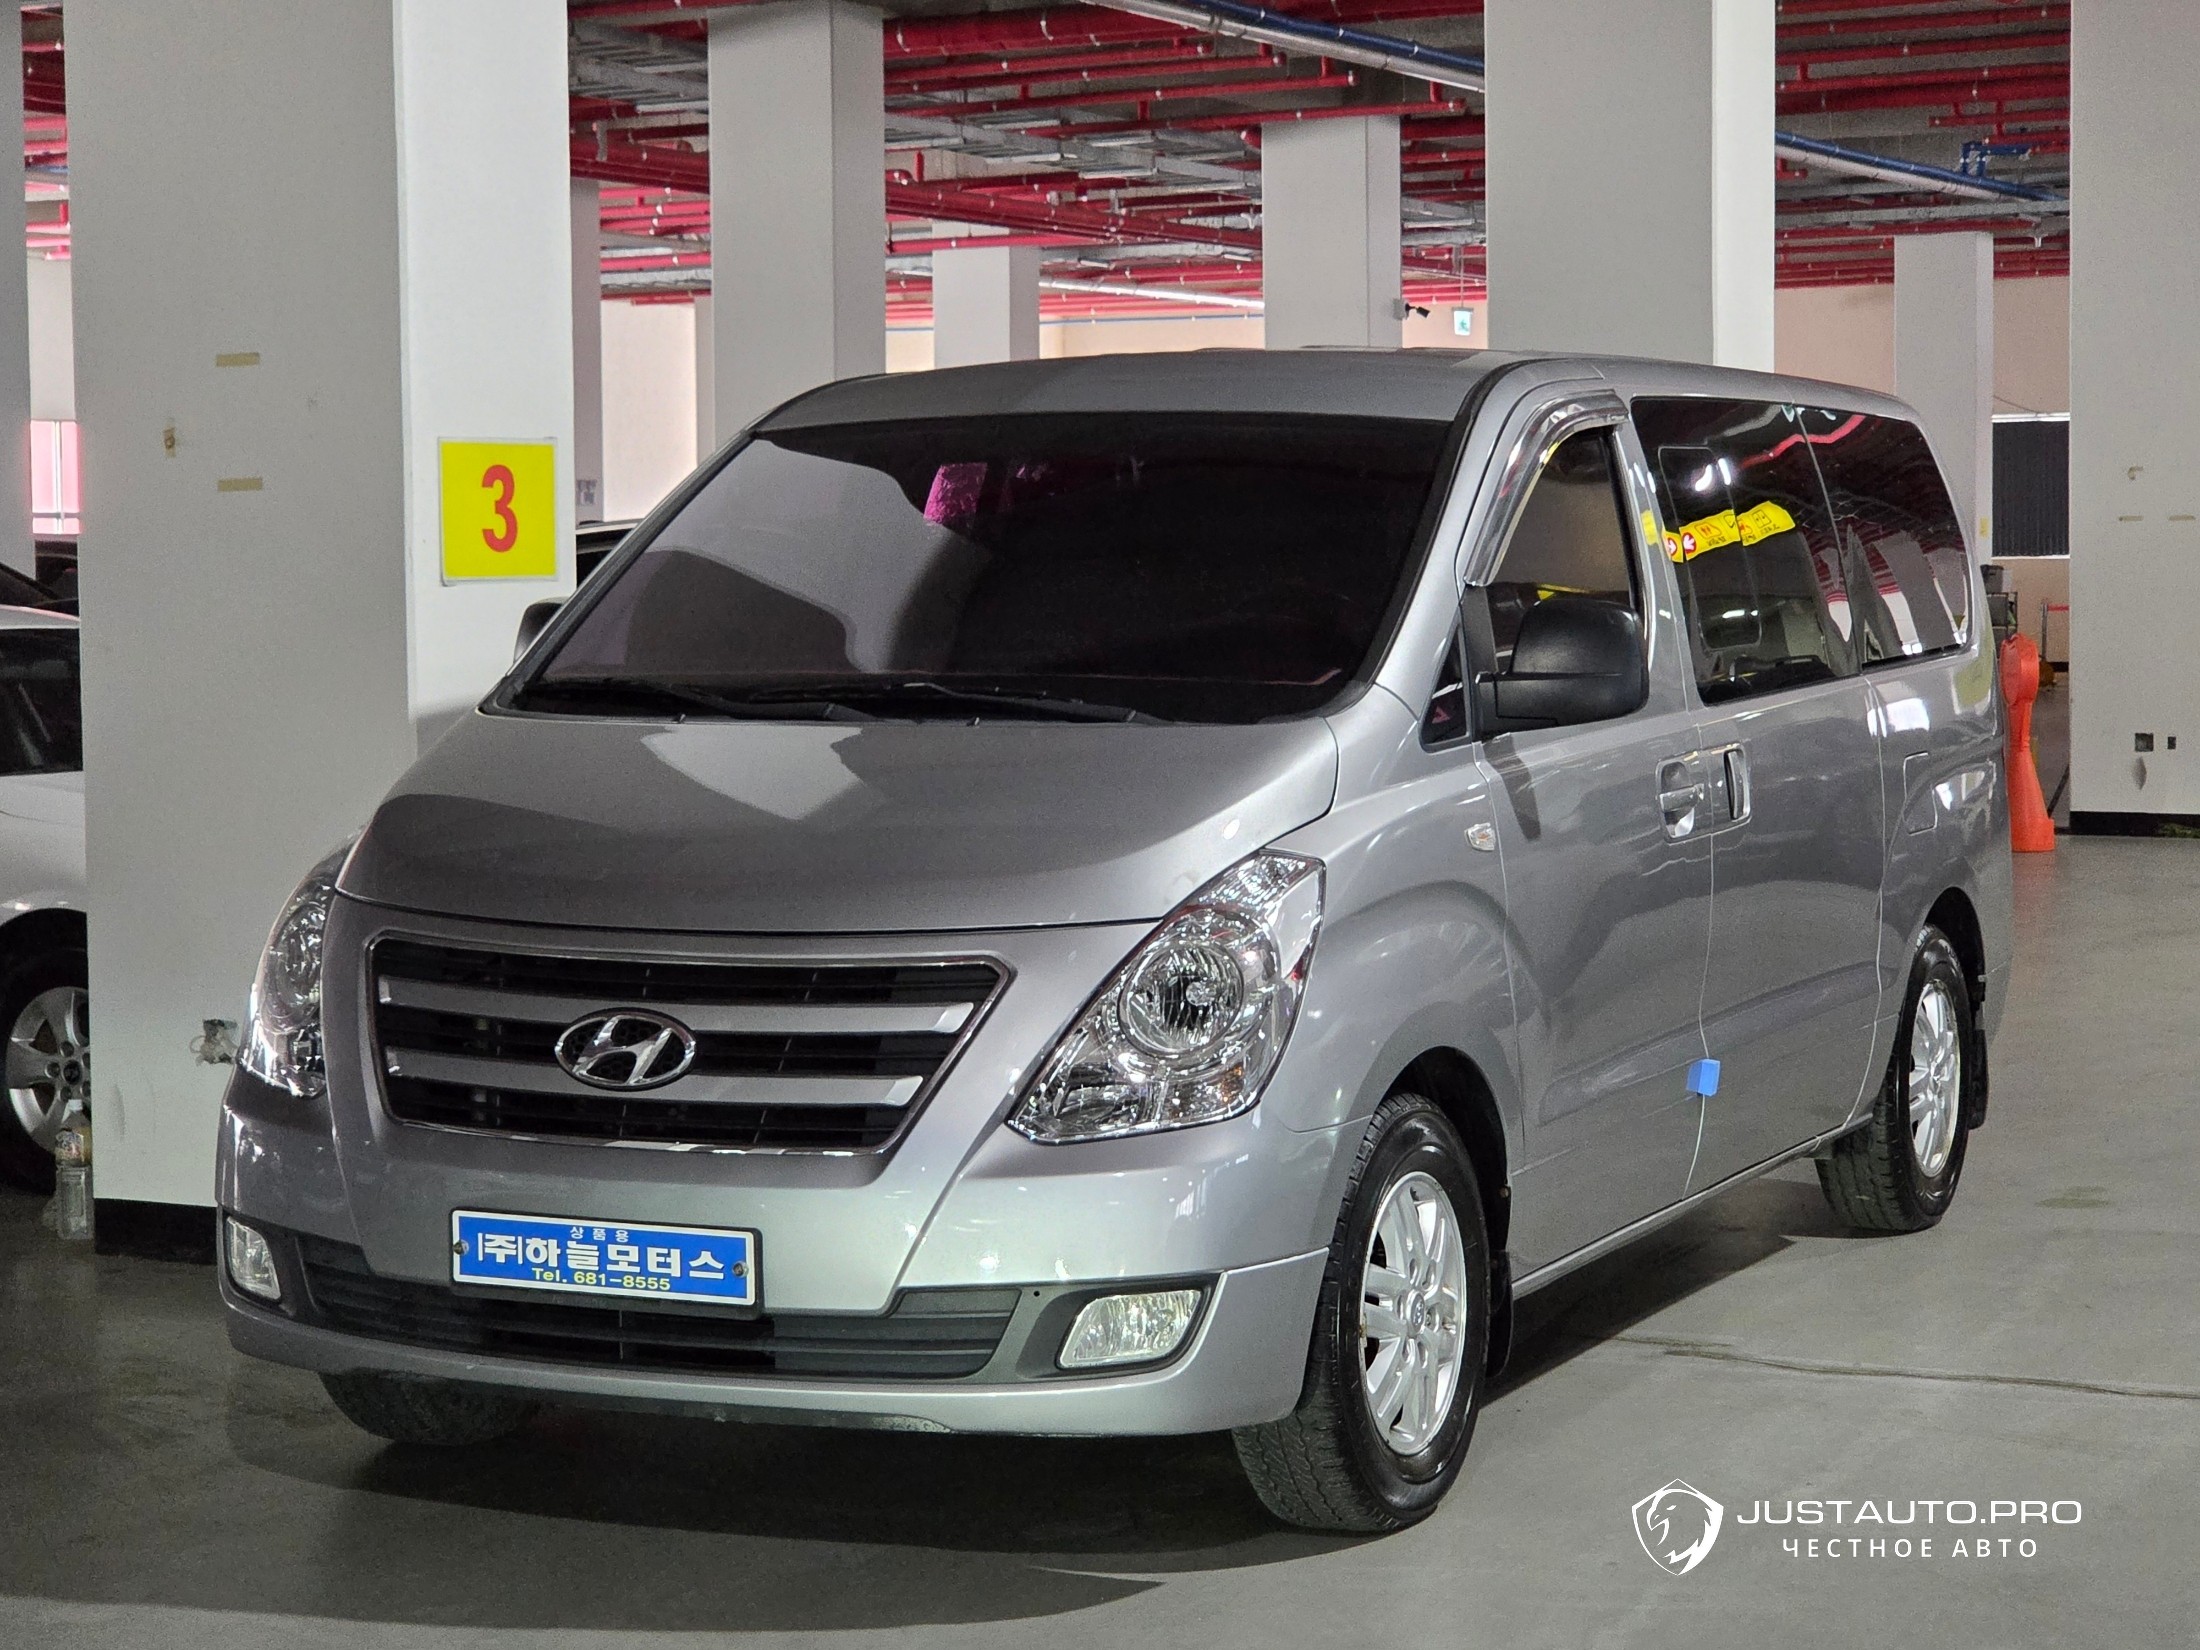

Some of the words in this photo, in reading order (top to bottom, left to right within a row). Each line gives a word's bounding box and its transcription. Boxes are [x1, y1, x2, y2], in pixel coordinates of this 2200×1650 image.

[482, 464, 518, 553] 3
[569, 1226, 630, 1243] 상품용
[531, 1267, 568, 1284] Tel.
[573, 1270, 671, 1291] 681-8555
